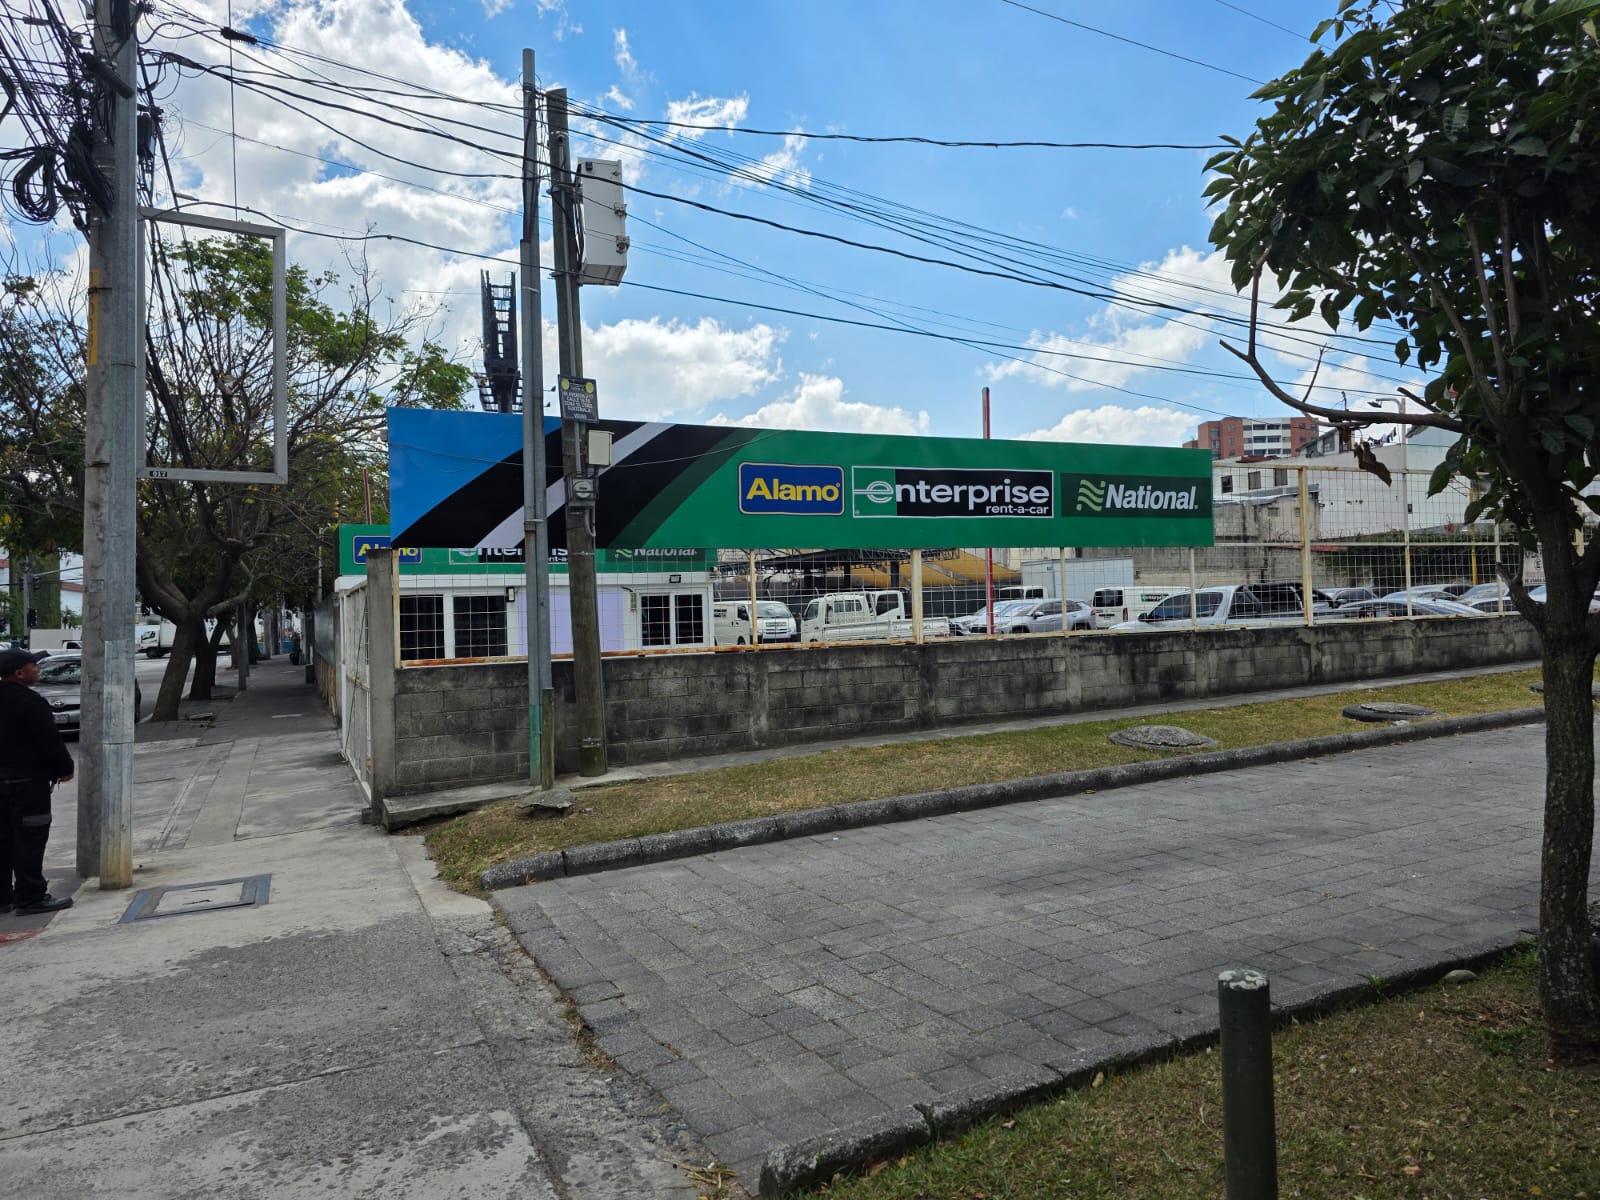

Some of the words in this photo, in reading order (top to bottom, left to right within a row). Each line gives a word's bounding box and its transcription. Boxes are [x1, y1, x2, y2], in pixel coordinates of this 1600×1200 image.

[746, 478, 839, 501] Alamo
[866, 479, 1050, 510] enterprise
[1105, 484, 1196, 509] National
[986, 505, 1049, 514] rent-a-car
[358, 543, 419, 557] Amo
